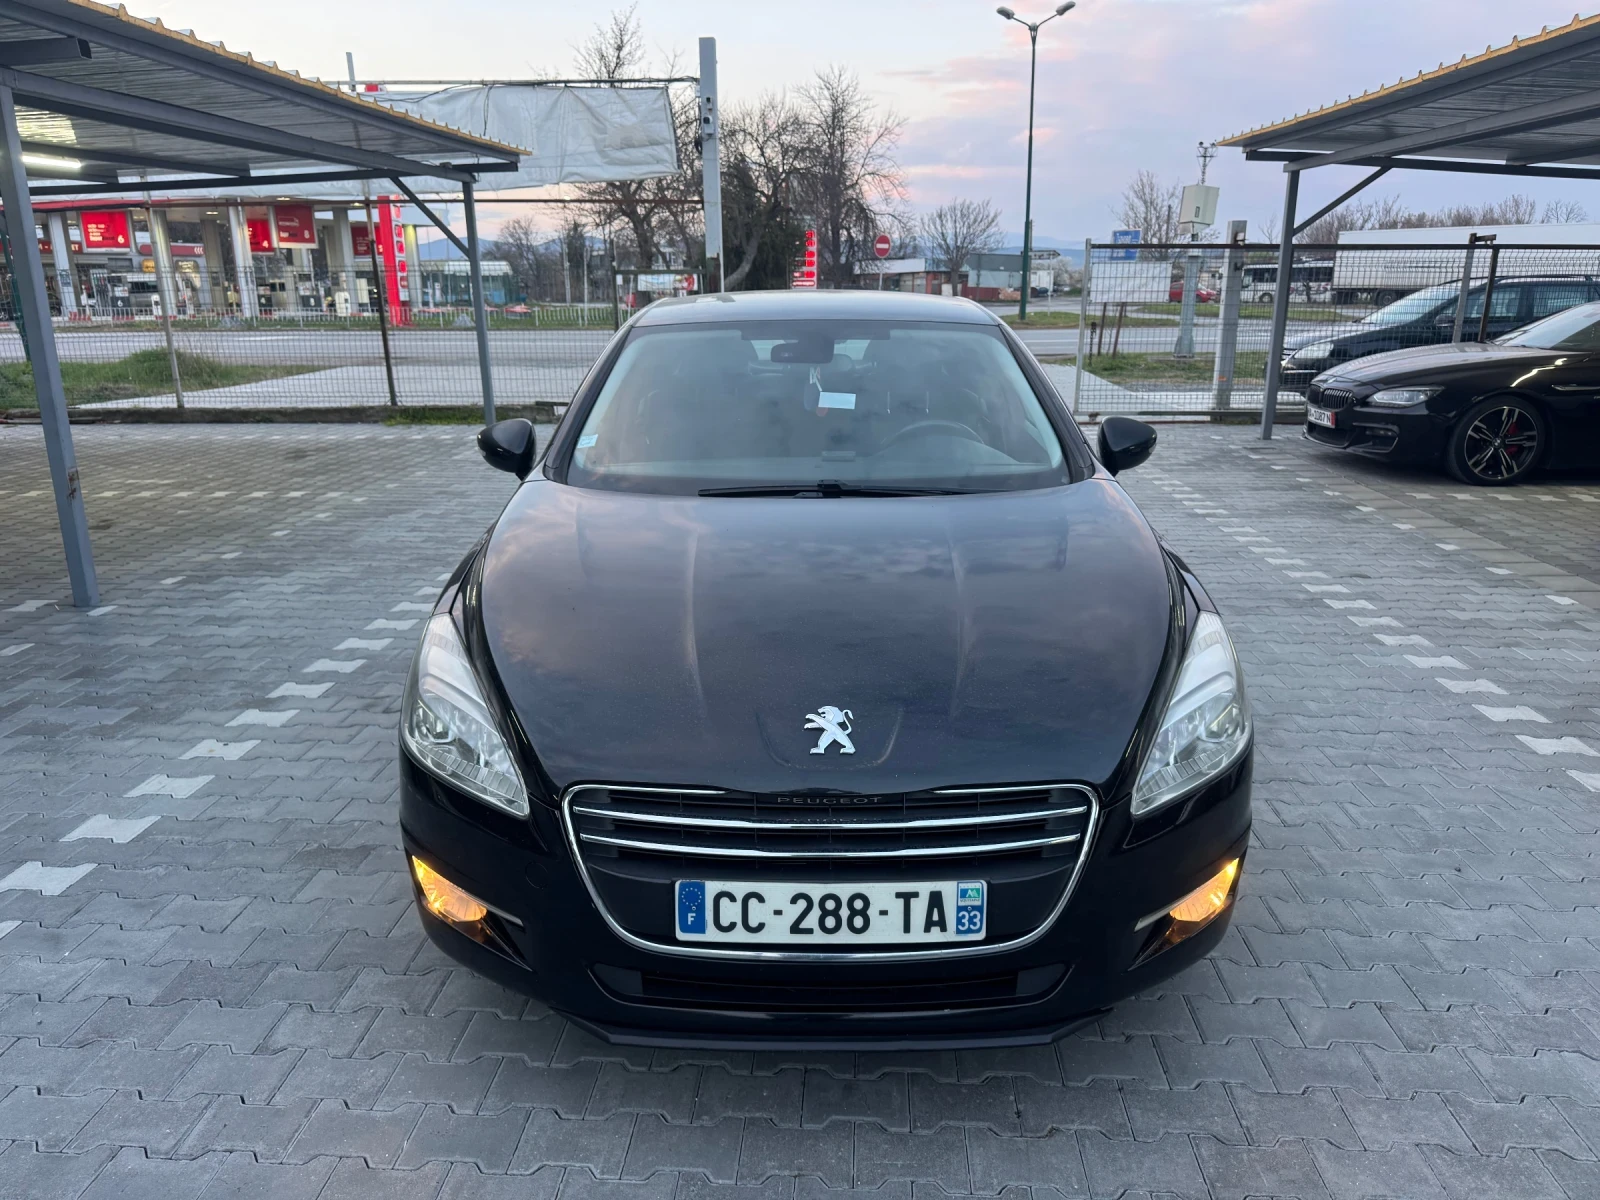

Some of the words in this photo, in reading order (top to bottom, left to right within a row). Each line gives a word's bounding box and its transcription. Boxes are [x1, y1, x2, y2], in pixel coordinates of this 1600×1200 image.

[117, 234, 125, 244] 6
[262, 240, 269, 249] 4
[777, 796, 882, 805] PEUGEOT
[713, 890, 948, 935] CC-288-TA
[687, 912, 696, 925] F
[957, 911, 981, 931] 33
